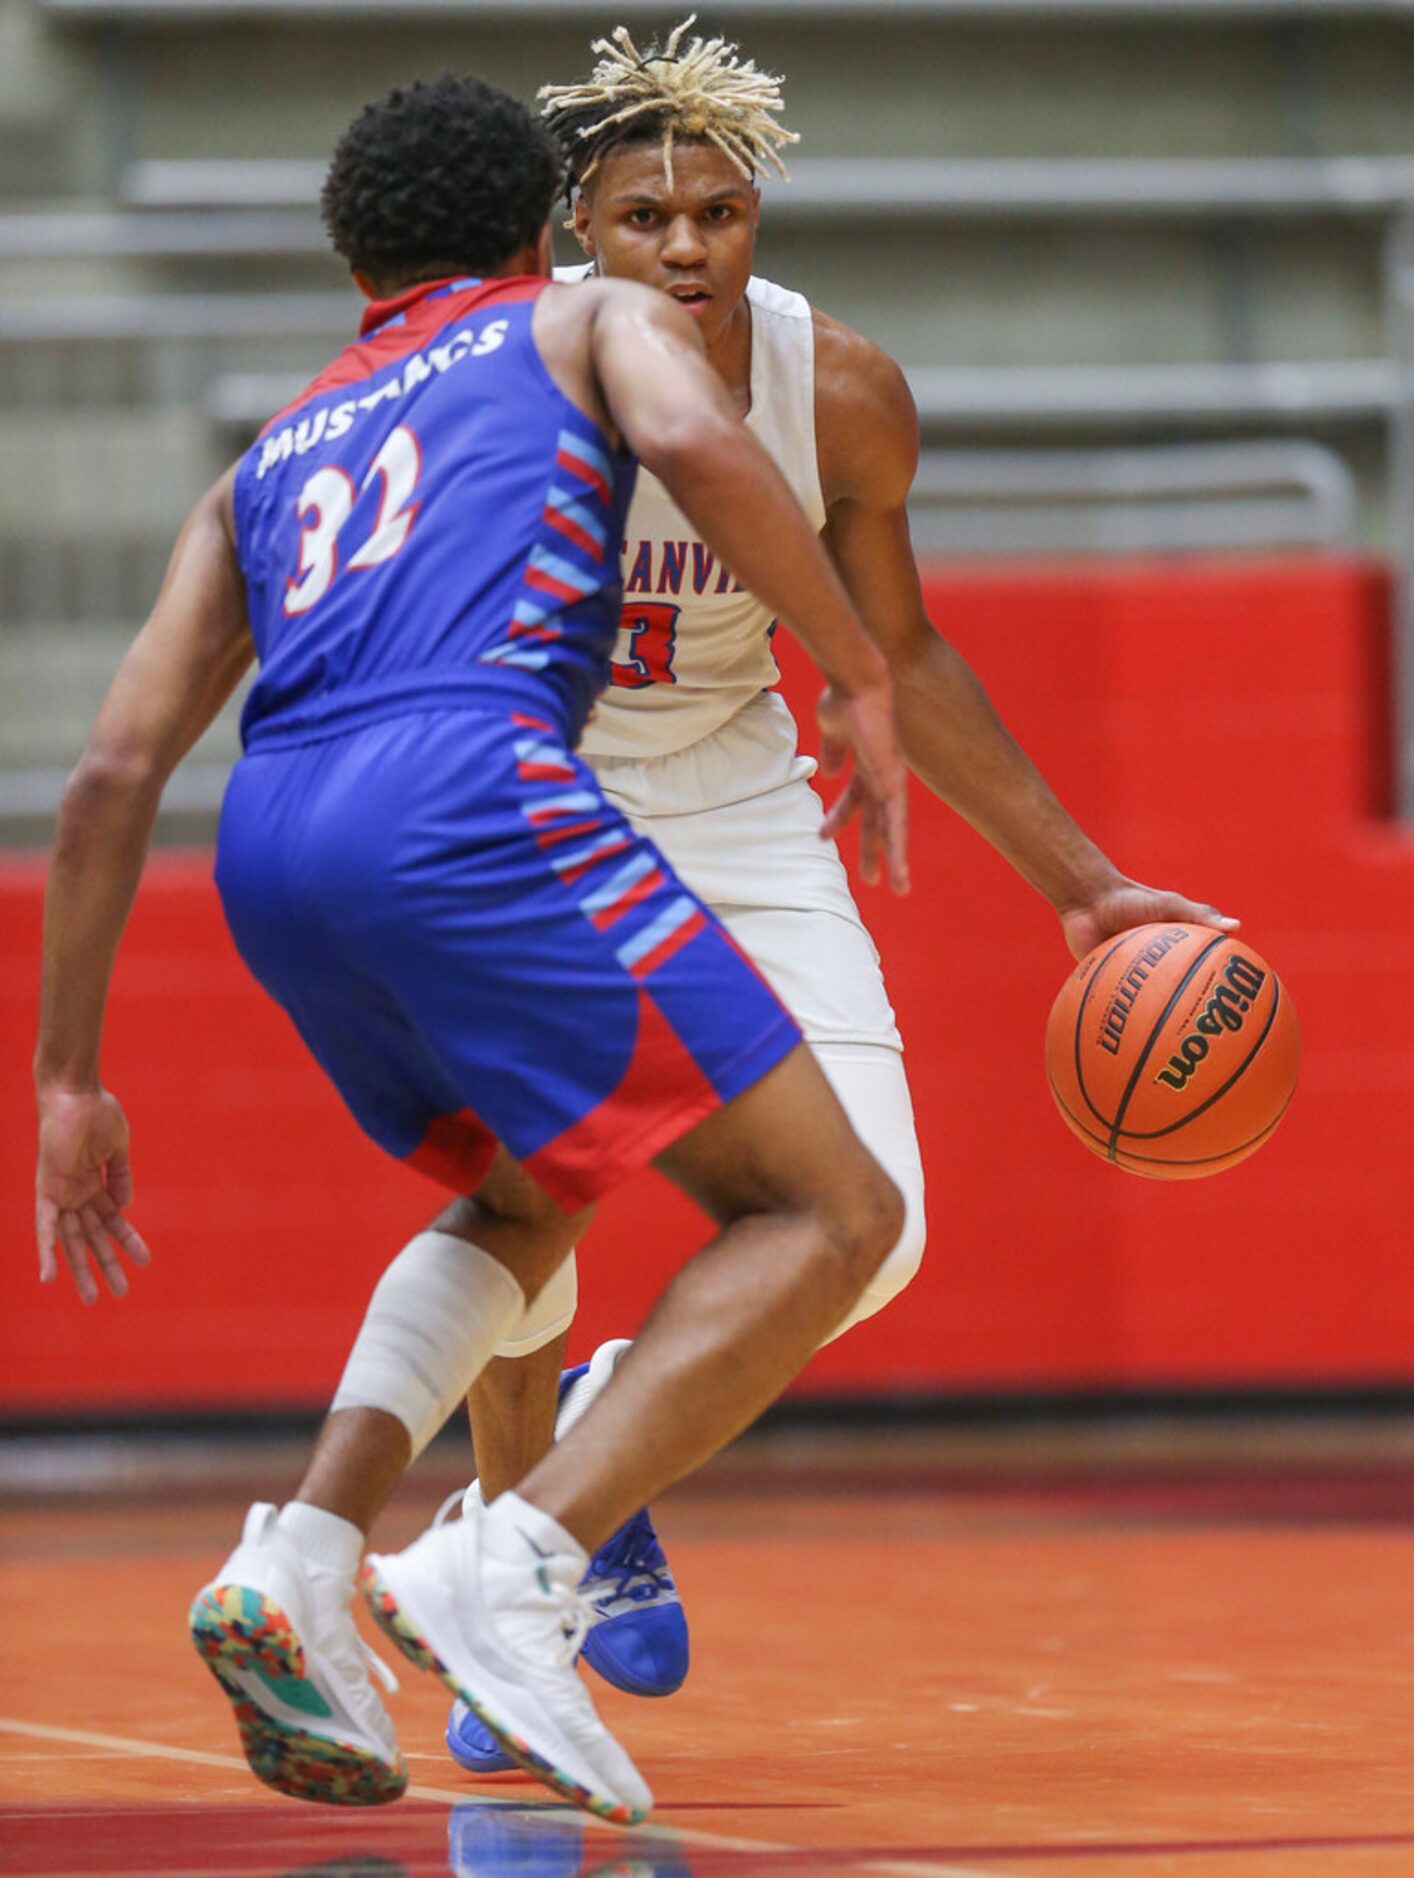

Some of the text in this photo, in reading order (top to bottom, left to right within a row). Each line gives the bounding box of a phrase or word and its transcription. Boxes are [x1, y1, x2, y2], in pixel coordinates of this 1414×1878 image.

[283, 424, 422, 618] 32
[620, 540, 746, 596] ANVI
[1100, 926, 1190, 1056] EVOLUTION
[1156, 953, 1266, 1092] Wilson
